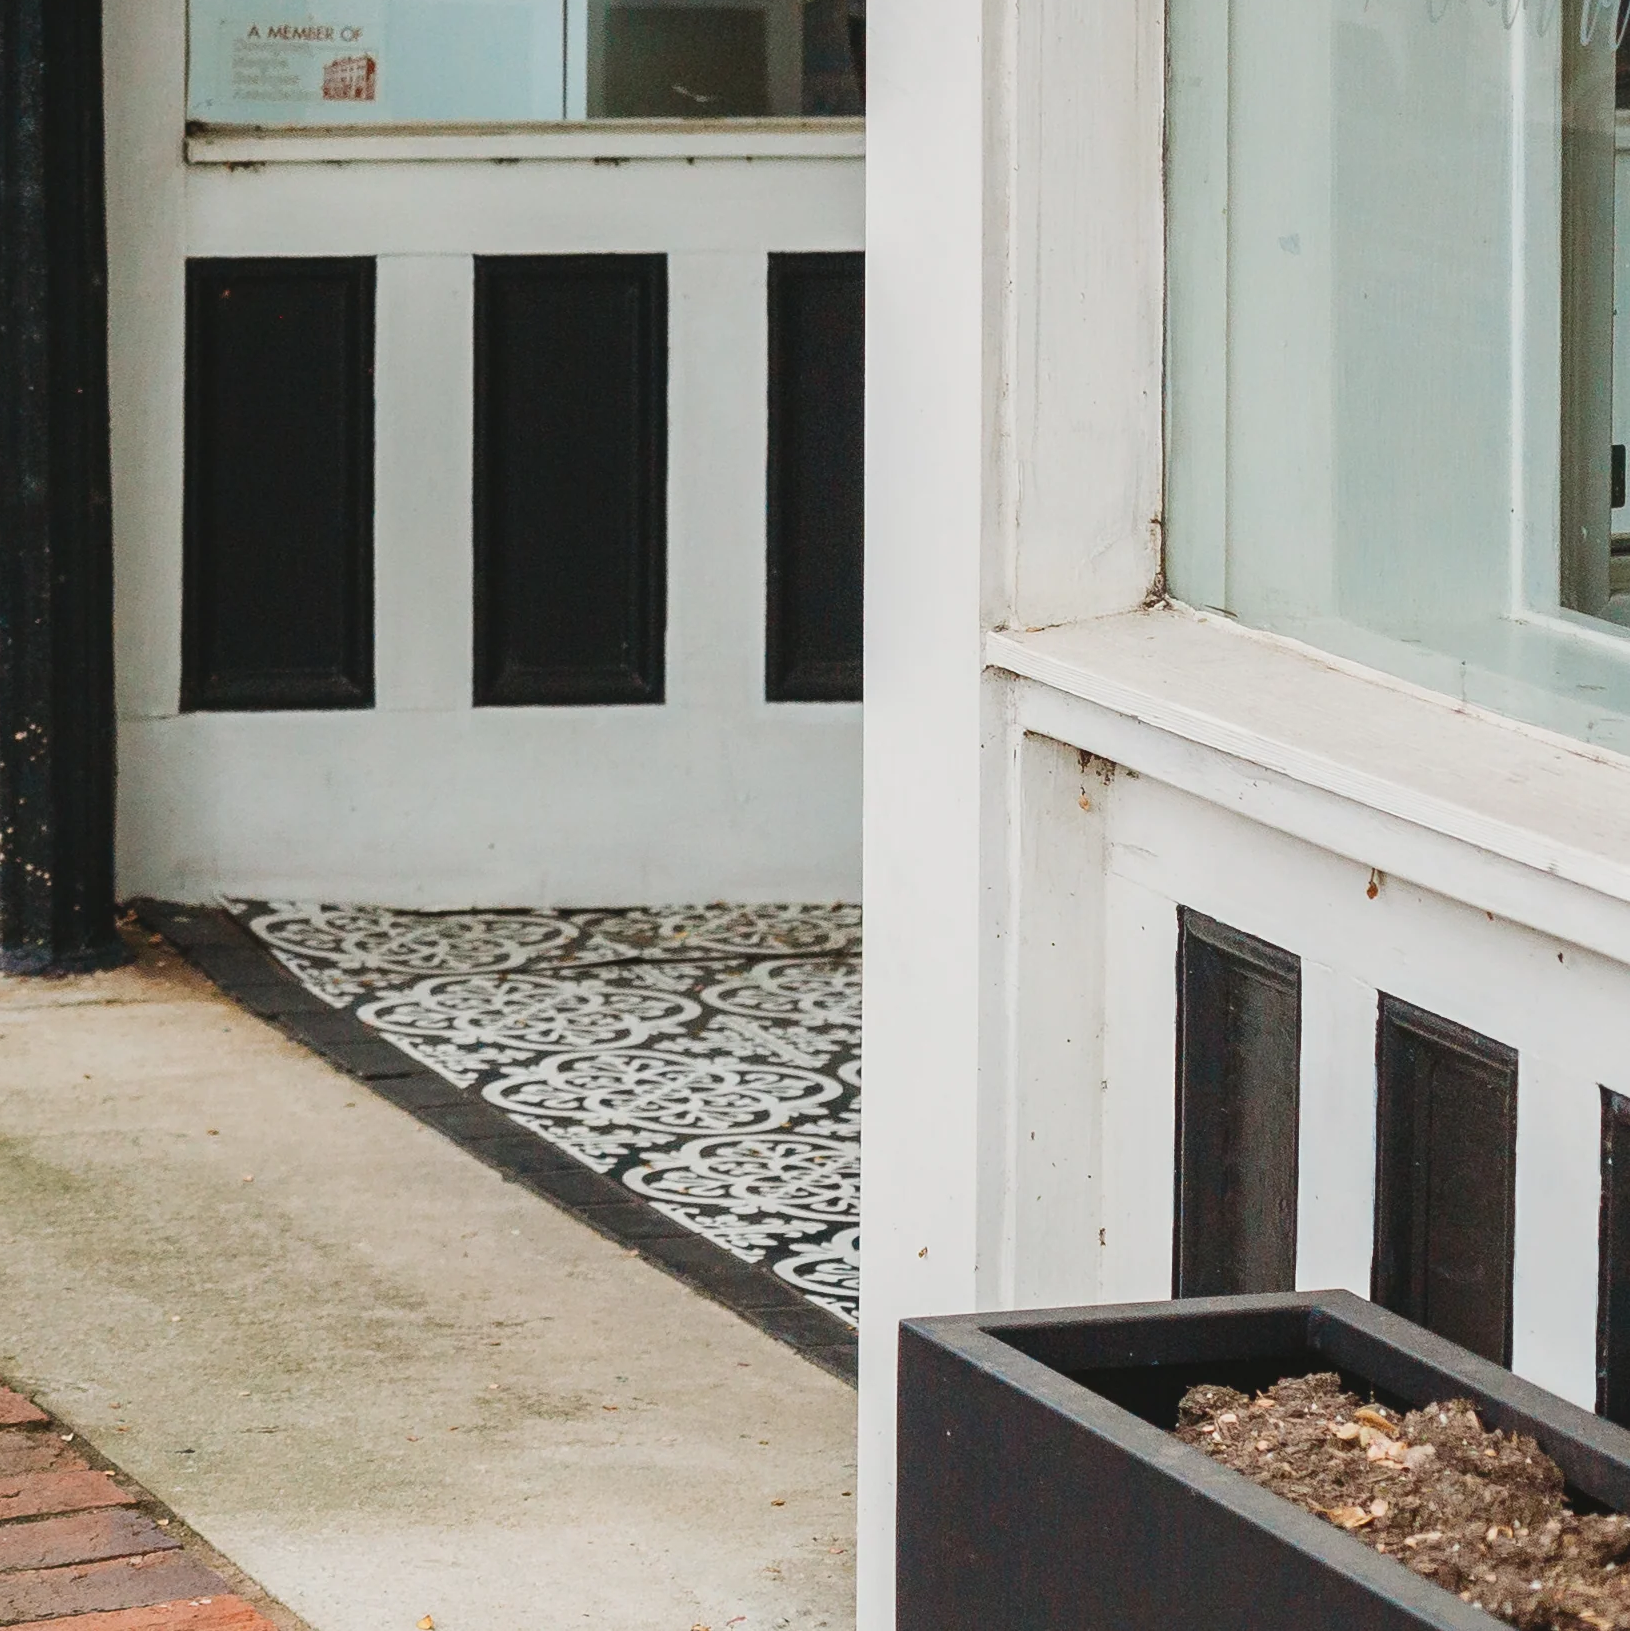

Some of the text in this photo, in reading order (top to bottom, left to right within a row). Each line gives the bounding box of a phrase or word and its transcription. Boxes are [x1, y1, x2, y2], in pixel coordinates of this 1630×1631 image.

[247, 24, 363, 42] A MEMBER OF
